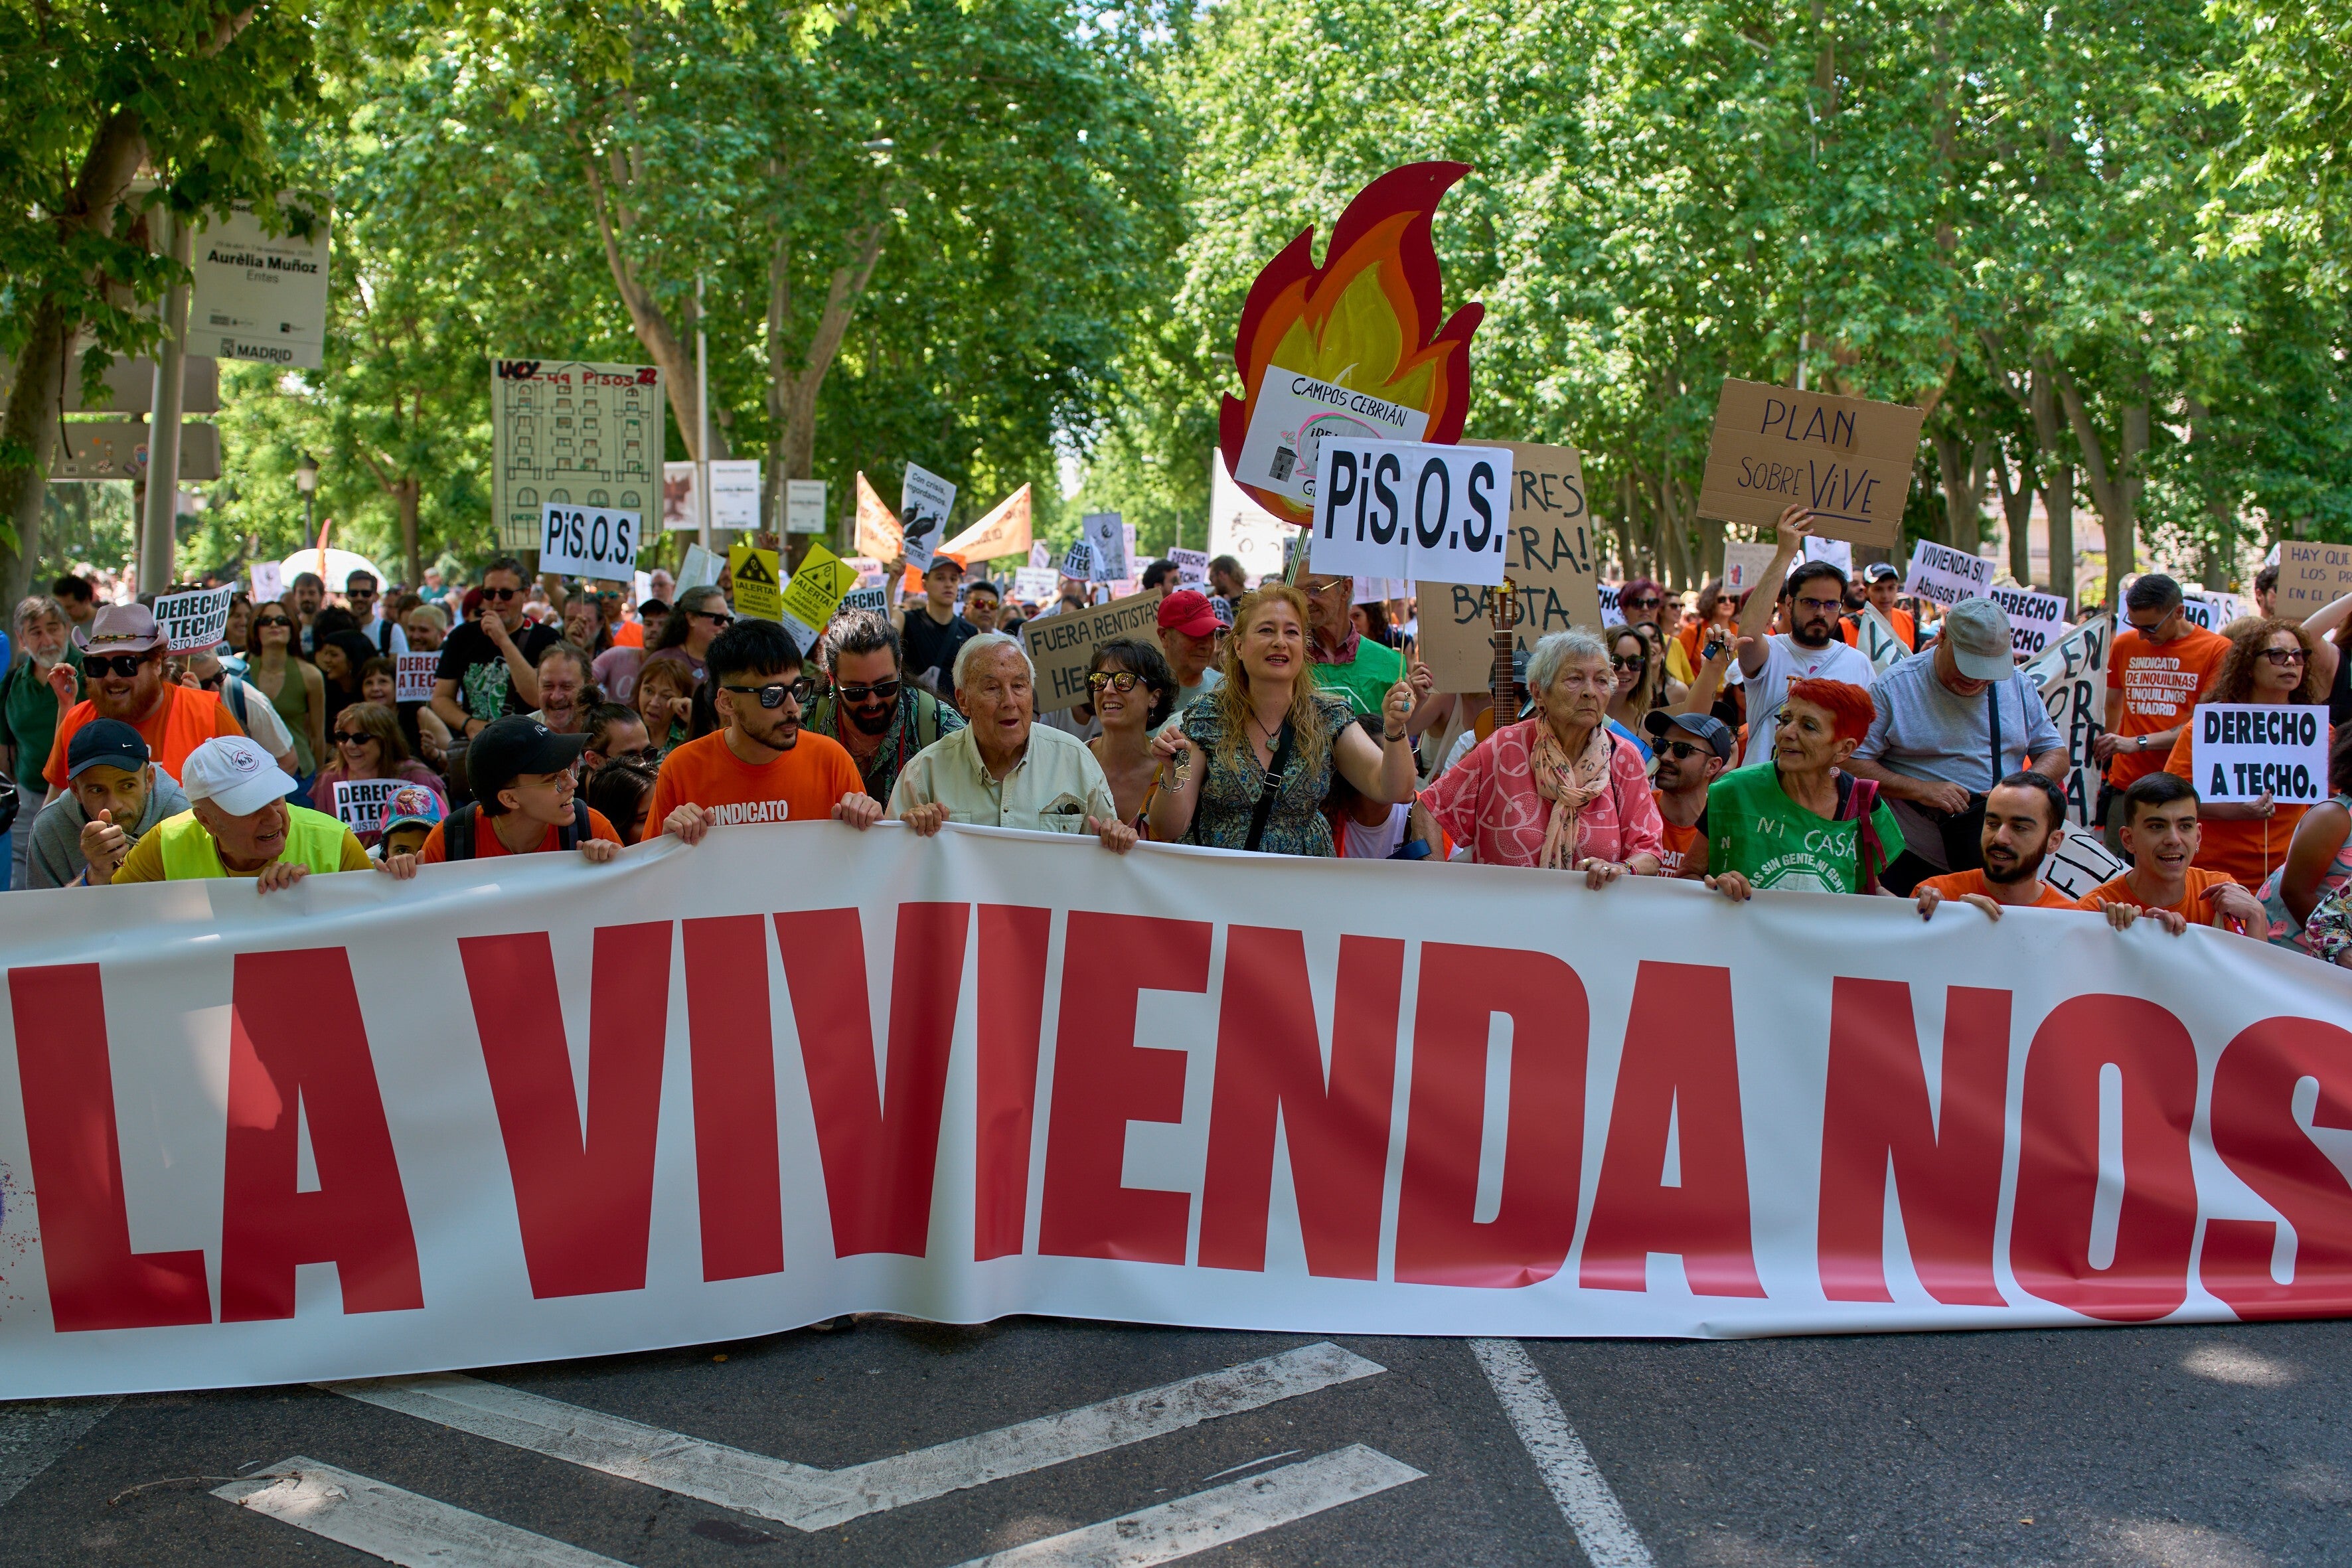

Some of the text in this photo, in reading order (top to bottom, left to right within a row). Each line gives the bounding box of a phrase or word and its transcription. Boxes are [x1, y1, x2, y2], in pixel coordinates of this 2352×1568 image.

[207, 248, 318, 274] Aurèlia Muñoz
[246, 269, 280, 284] Entes
[237, 344, 292, 363] MADRID
[1292, 377, 1408, 428] CAMPOS CEBRIÁN
[1761, 399, 1856, 447] PLAN
[912, 473, 925, 485] Con
[1325, 450, 1503, 553] PiS.O.S.
[547, 510, 633, 565] PiS.O.S.
[1922, 544, 1985, 586] VIVIENDA SI,
[2292, 546, 2351, 566] HAY QUE
[2301, 568, 2327, 581] LOS
[735, 580, 777, 596] ¡ALERTA!
[793, 576, 834, 609] ¡ALERTA!
[795, 591, 813, 605] PLAGA
[1916, 576, 1956, 604] Abusos
[2289, 587, 2306, 599] EN
[2312, 589, 2323, 601] EL
[156, 589, 230, 620] DERECHO
[781, 597, 821, 625] INMOBILIARIOS
[169, 609, 226, 639] TECHO
[1030, 621, 1092, 656] FUERA
[1093, 599, 1160, 639] RENTISTAS
[193, 629, 224, 648] PRECIO!
[399, 657, 441, 672] DEREC
[2128, 656, 2180, 671] SINDICATO
[398, 672, 437, 688] A TEC
[2126, 672, 2196, 688] DE INQUILINAS
[2126, 687, 2187, 704] E INQUILINOS
[2136, 702, 2177, 717] MADRID
[2204, 711, 2316, 747] DERECHO
[2211, 763, 2317, 799] A TECHO.
[338, 784, 401, 804] DEREC
[340, 807, 351, 823] A
[352, 821, 380, 832] JUSTO
[1804, 830, 1859, 861] CASA
[1761, 857, 1782, 875] SIN
[1782, 852, 1816, 868] GENTE,
[1815, 859, 1827, 874] NI
[7, 902, 2352, 1333] LA VIVIENDA NOS
